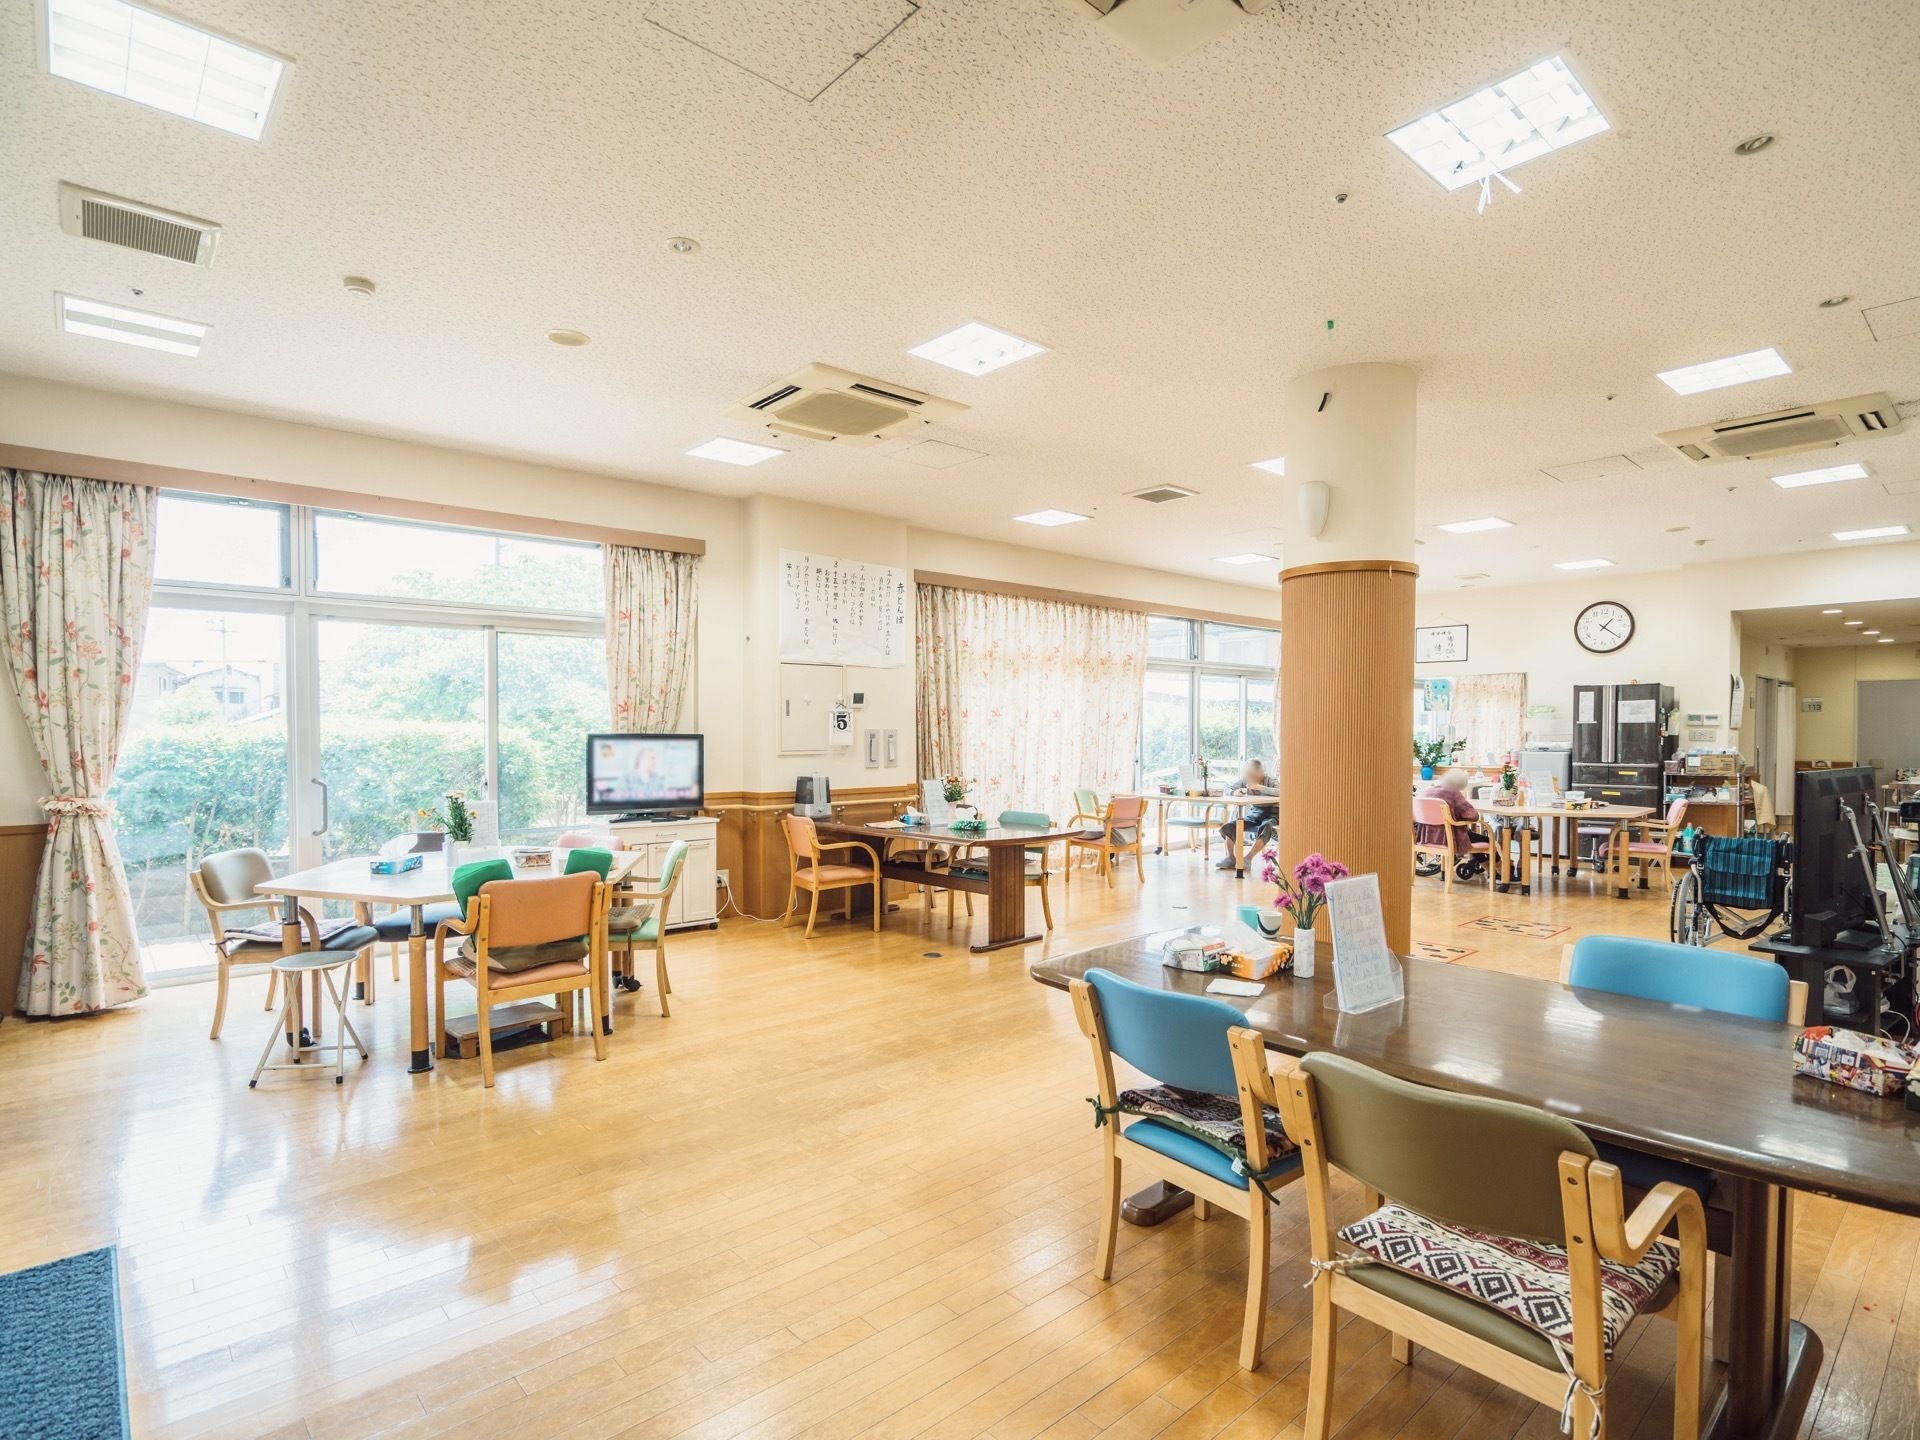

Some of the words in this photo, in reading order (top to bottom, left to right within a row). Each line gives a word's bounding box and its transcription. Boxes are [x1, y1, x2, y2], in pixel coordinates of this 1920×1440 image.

[896, 582, 905, 624] 赤とんぼ
[1600, 608, 1609, 616] 12
[836, 714, 848, 730] 5
